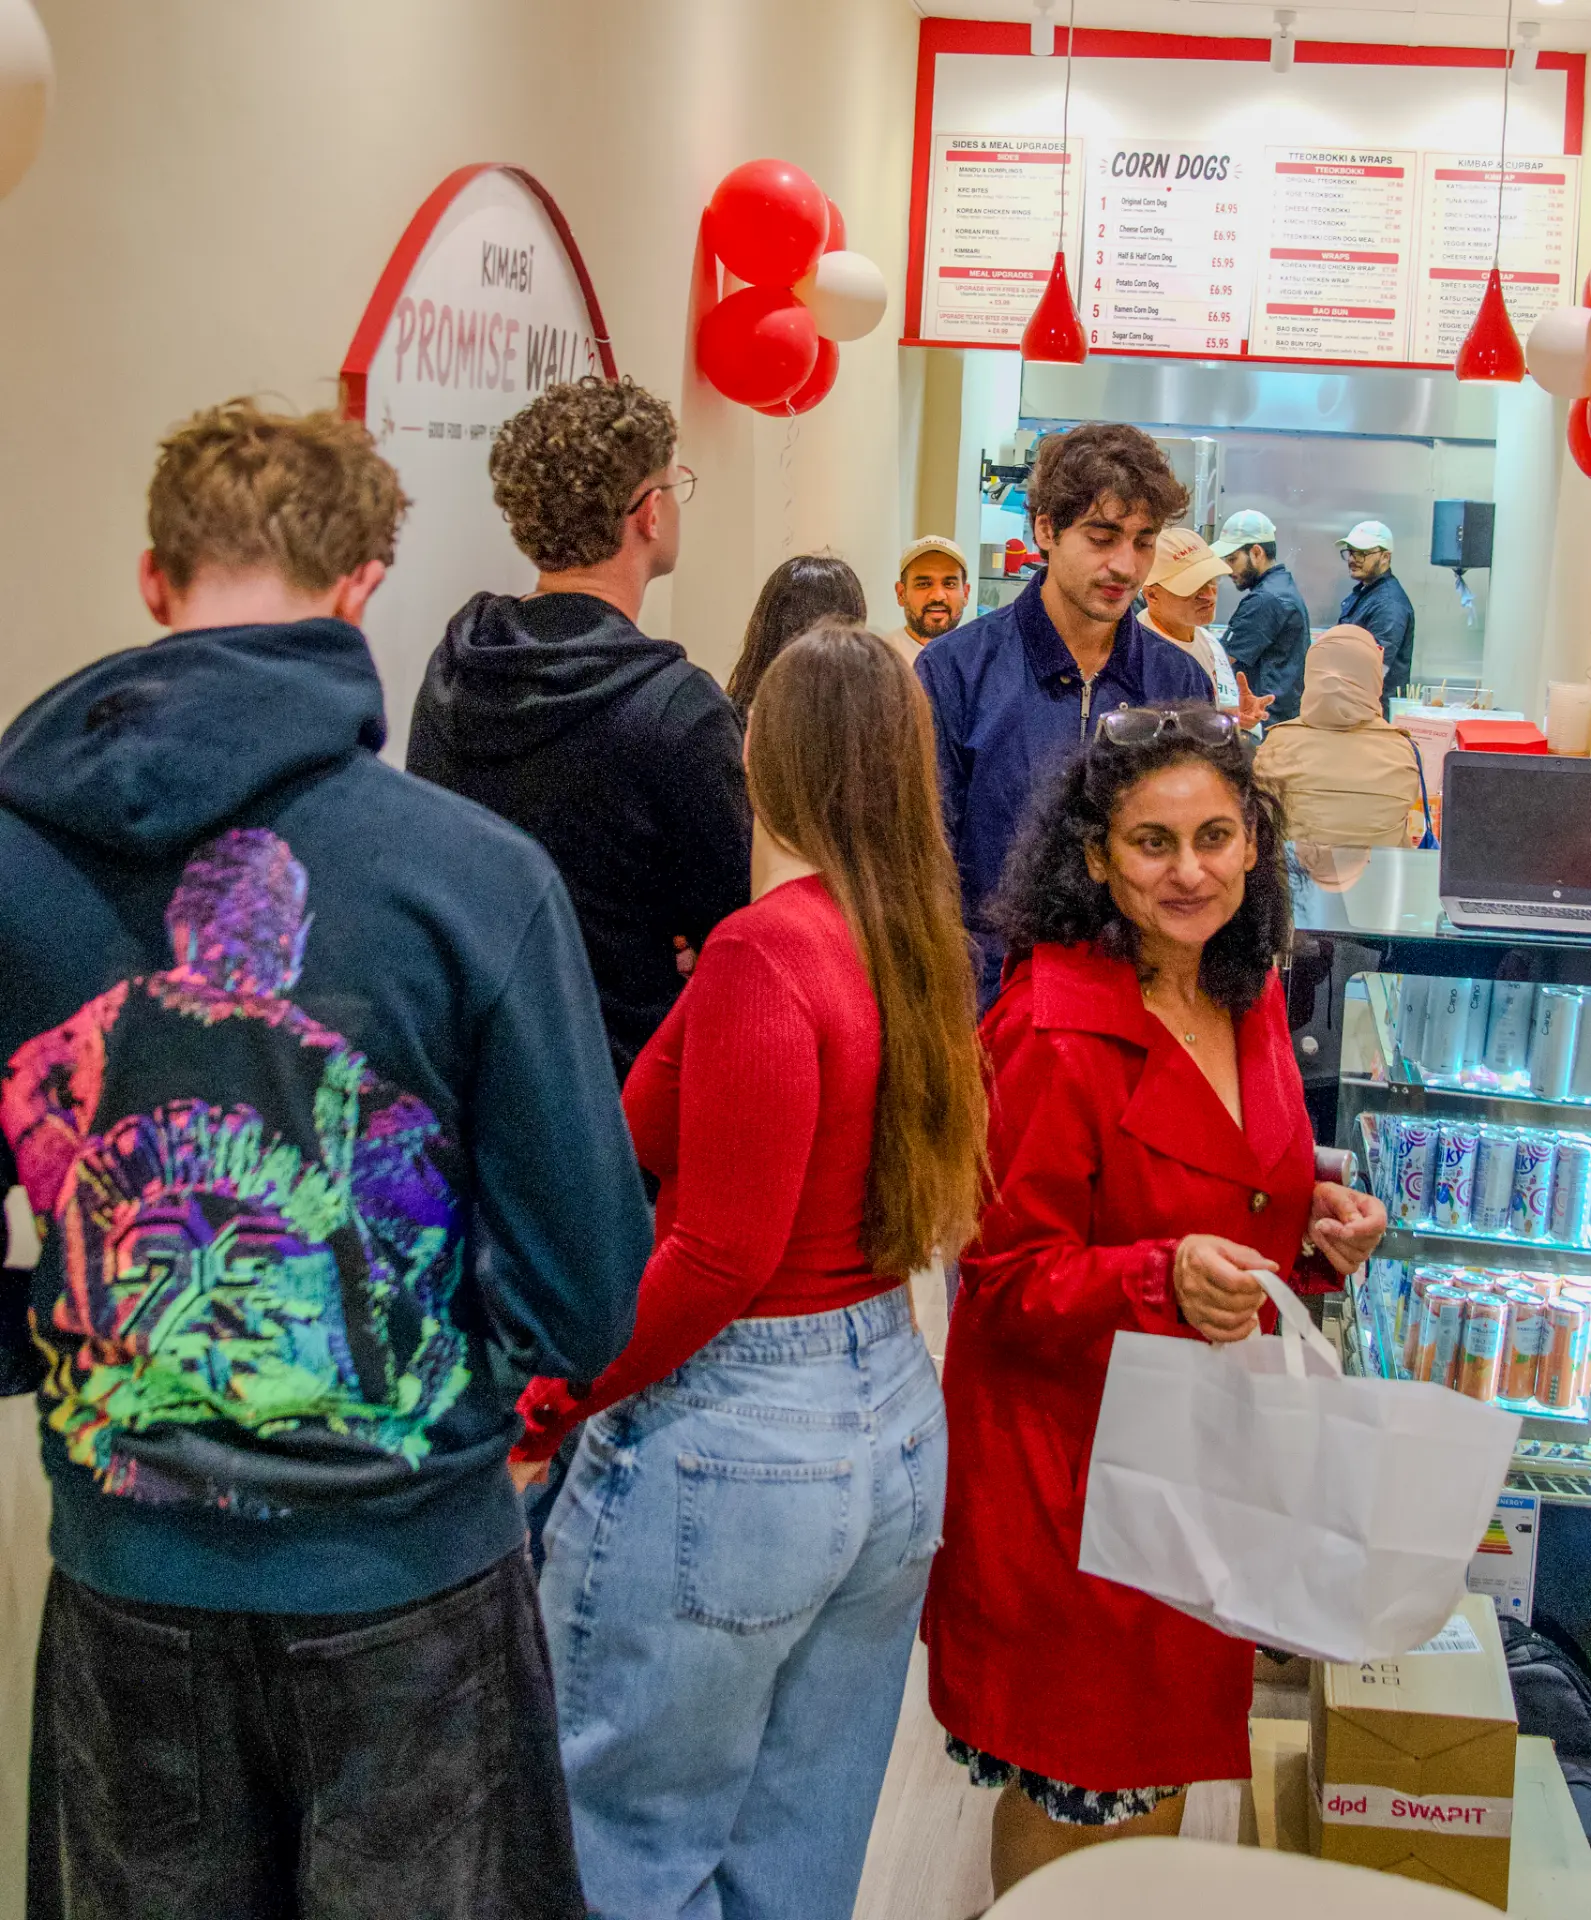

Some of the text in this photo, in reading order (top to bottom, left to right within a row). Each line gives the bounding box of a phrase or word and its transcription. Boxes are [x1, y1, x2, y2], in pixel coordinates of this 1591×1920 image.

[952, 140, 978, 149] SIDES
[1016, 142, 1065, 151] UPGRADES
[1111, 151, 1231, 181] CORN DOGS
[1289, 152, 1392, 164] TTEOKBOKKI & WRAPS
[1458, 160, 1494, 168] KIMBAP
[1505, 162, 1544, 170] CUPBAP
[1100, 196, 1238, 214] 1 Original Corn Dog £4.95
[1098, 224, 1105, 238] 2
[1119, 225, 1138, 233] Cheese
[1154, 226, 1164, 236] Dog
[1213, 230, 1236, 241] £6.95
[1096, 250, 1234, 268] 3 Half & Half Corn Dog £5.95
[1322, 252, 1350, 260] WRAPS
[992, 271, 1034, 279] UPGRADES
[1094, 277, 1232, 295] 4 Potato Corn Dog £6.95
[1092, 304, 1100, 318] 5
[1114, 305, 1133, 313] Ramen
[1148, 307, 1159, 316] Dog
[1208, 311, 1231, 322] £6.95
[1313, 307, 1348, 316] BAO BUN
[396, 296, 519, 393] PROMISE
[1091, 330, 1097, 343] 6
[1112, 331, 1128, 341] Sugar
[1143, 333, 1153, 342] Dog
[1206, 338, 1228, 348] £5.95
[1447, 988, 1458, 1014] Cano
[1360, 1663, 1374, 1672] A
[1362, 1675, 1376, 1684] B
[1327, 1795, 1487, 1825] dpd SWAPIT
